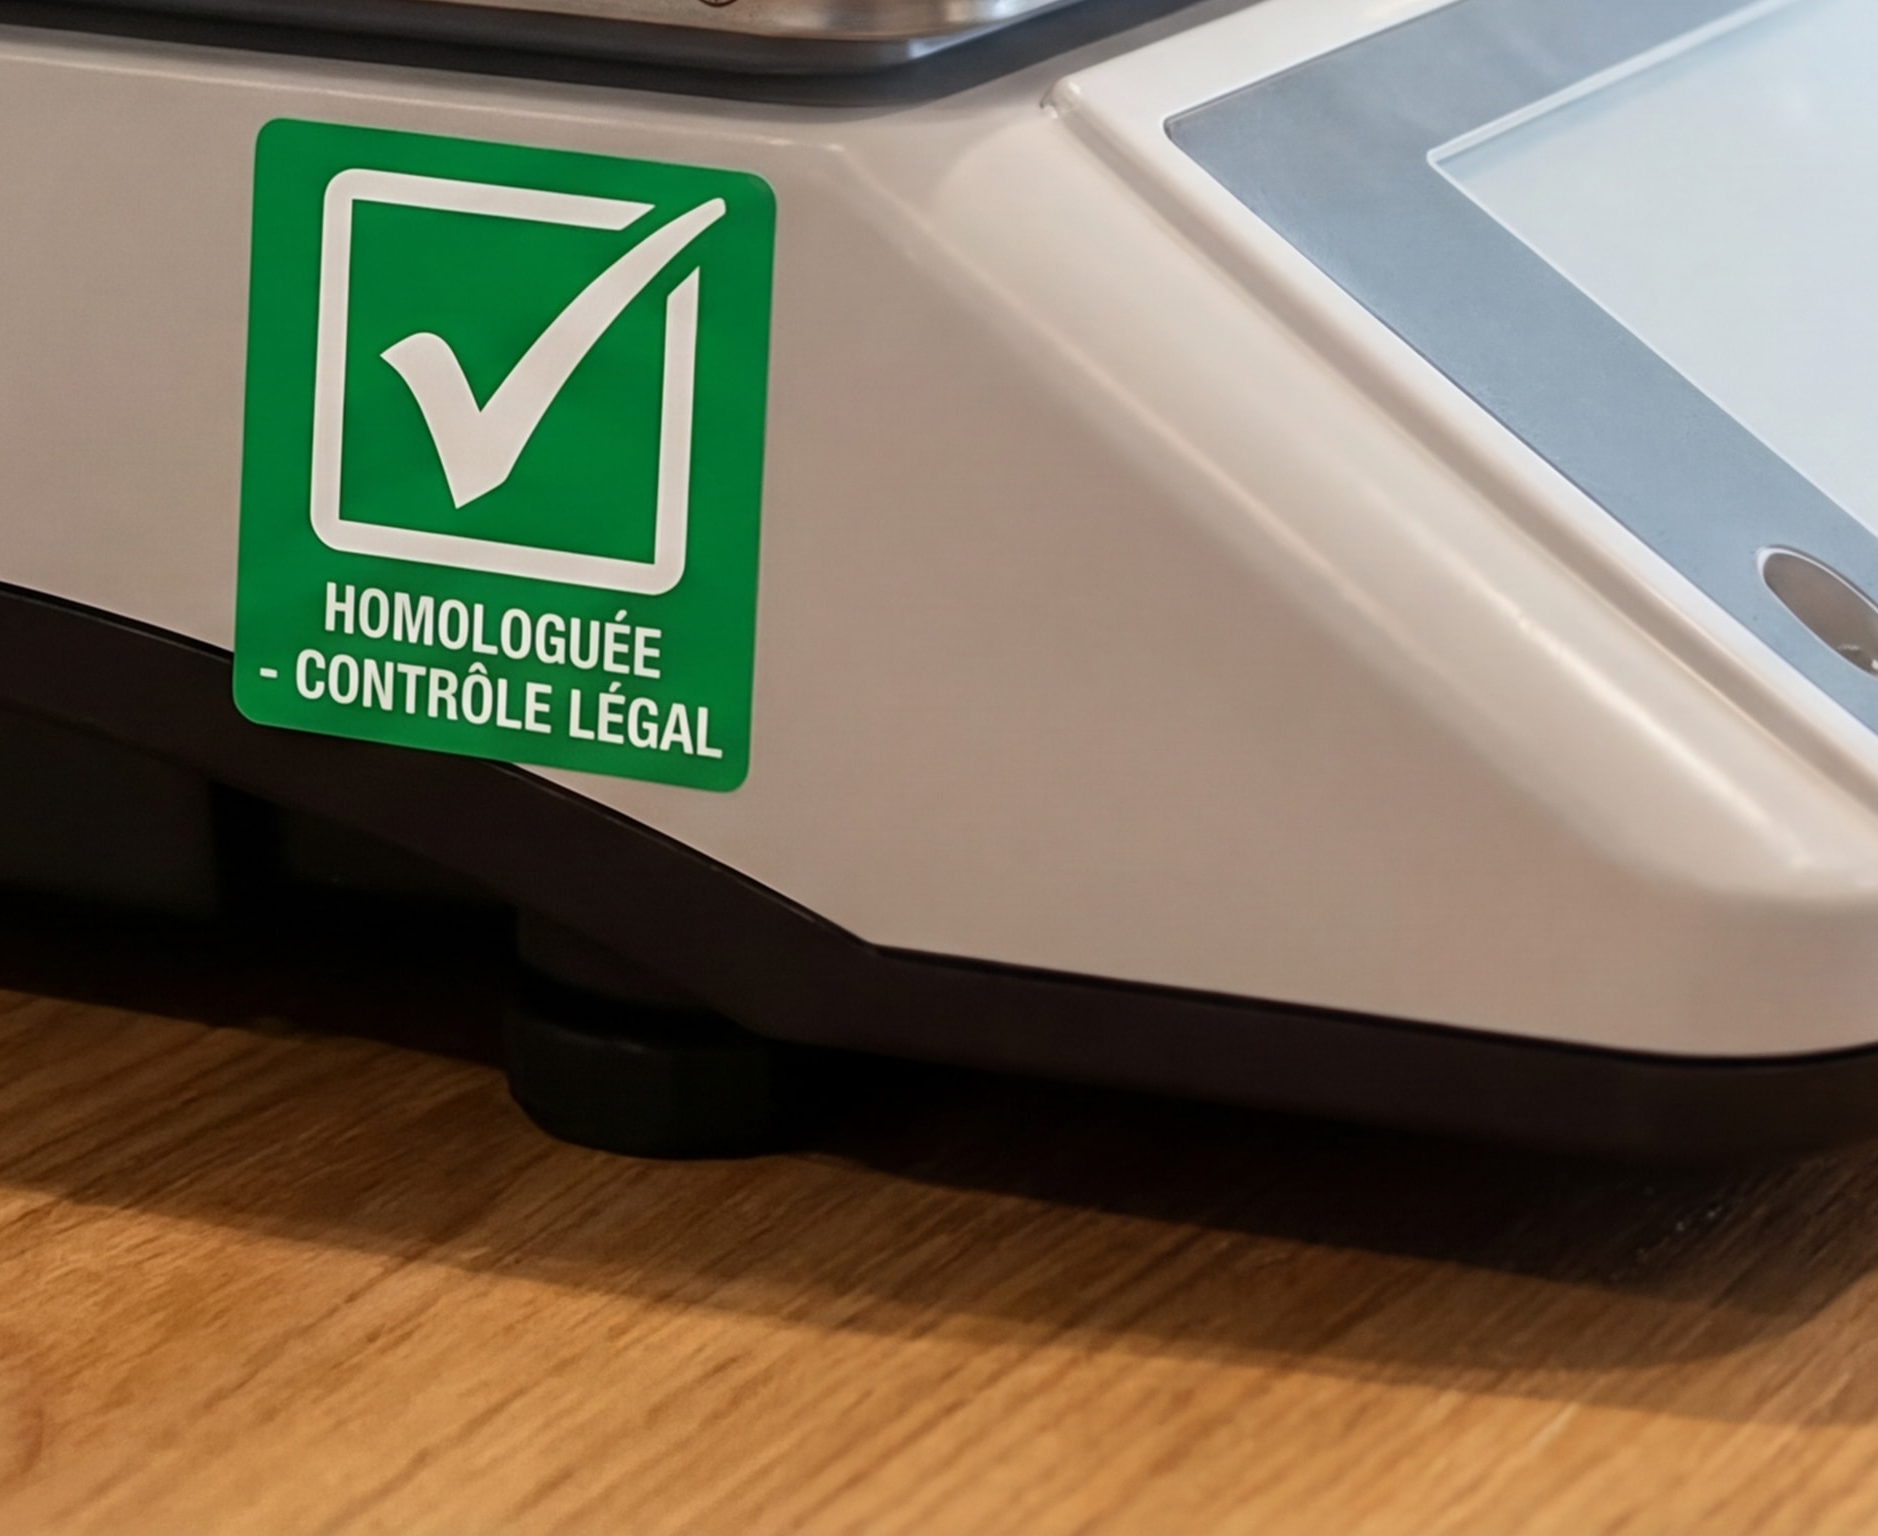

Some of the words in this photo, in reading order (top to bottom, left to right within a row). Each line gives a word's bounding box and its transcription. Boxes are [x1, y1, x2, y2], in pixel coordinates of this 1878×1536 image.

[325, 581, 662, 679] HOMOLOGUÉE
[296, 648, 552, 734] CONTRÔLE
[569, 681, 723, 759] LÉGAL
